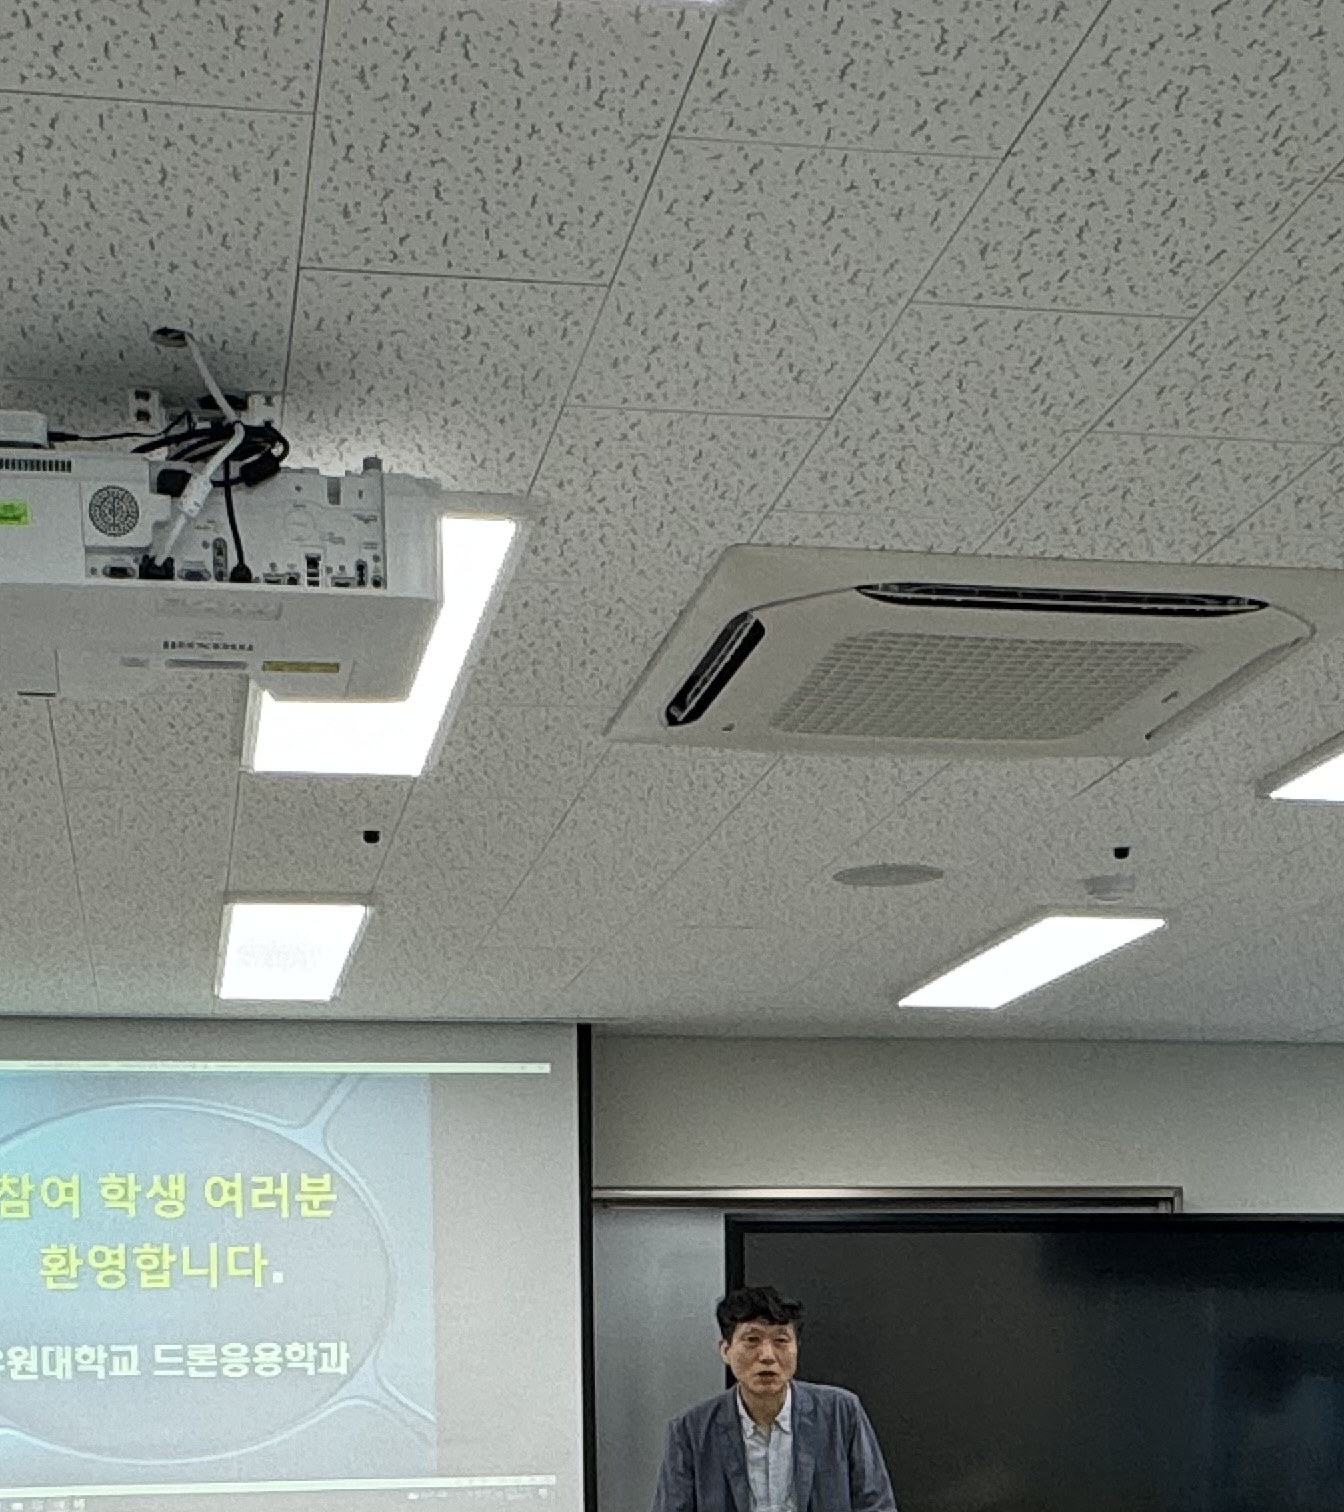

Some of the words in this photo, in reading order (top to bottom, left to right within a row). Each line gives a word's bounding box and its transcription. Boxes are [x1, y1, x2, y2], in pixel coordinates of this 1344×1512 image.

[98, 1172, 188, 1219] 학생
[204, 1172, 338, 1219] 여러분
[38, 1242, 284, 1290] 환영합니다.
[153, 1341, 350, 1378] 드론응용학과
